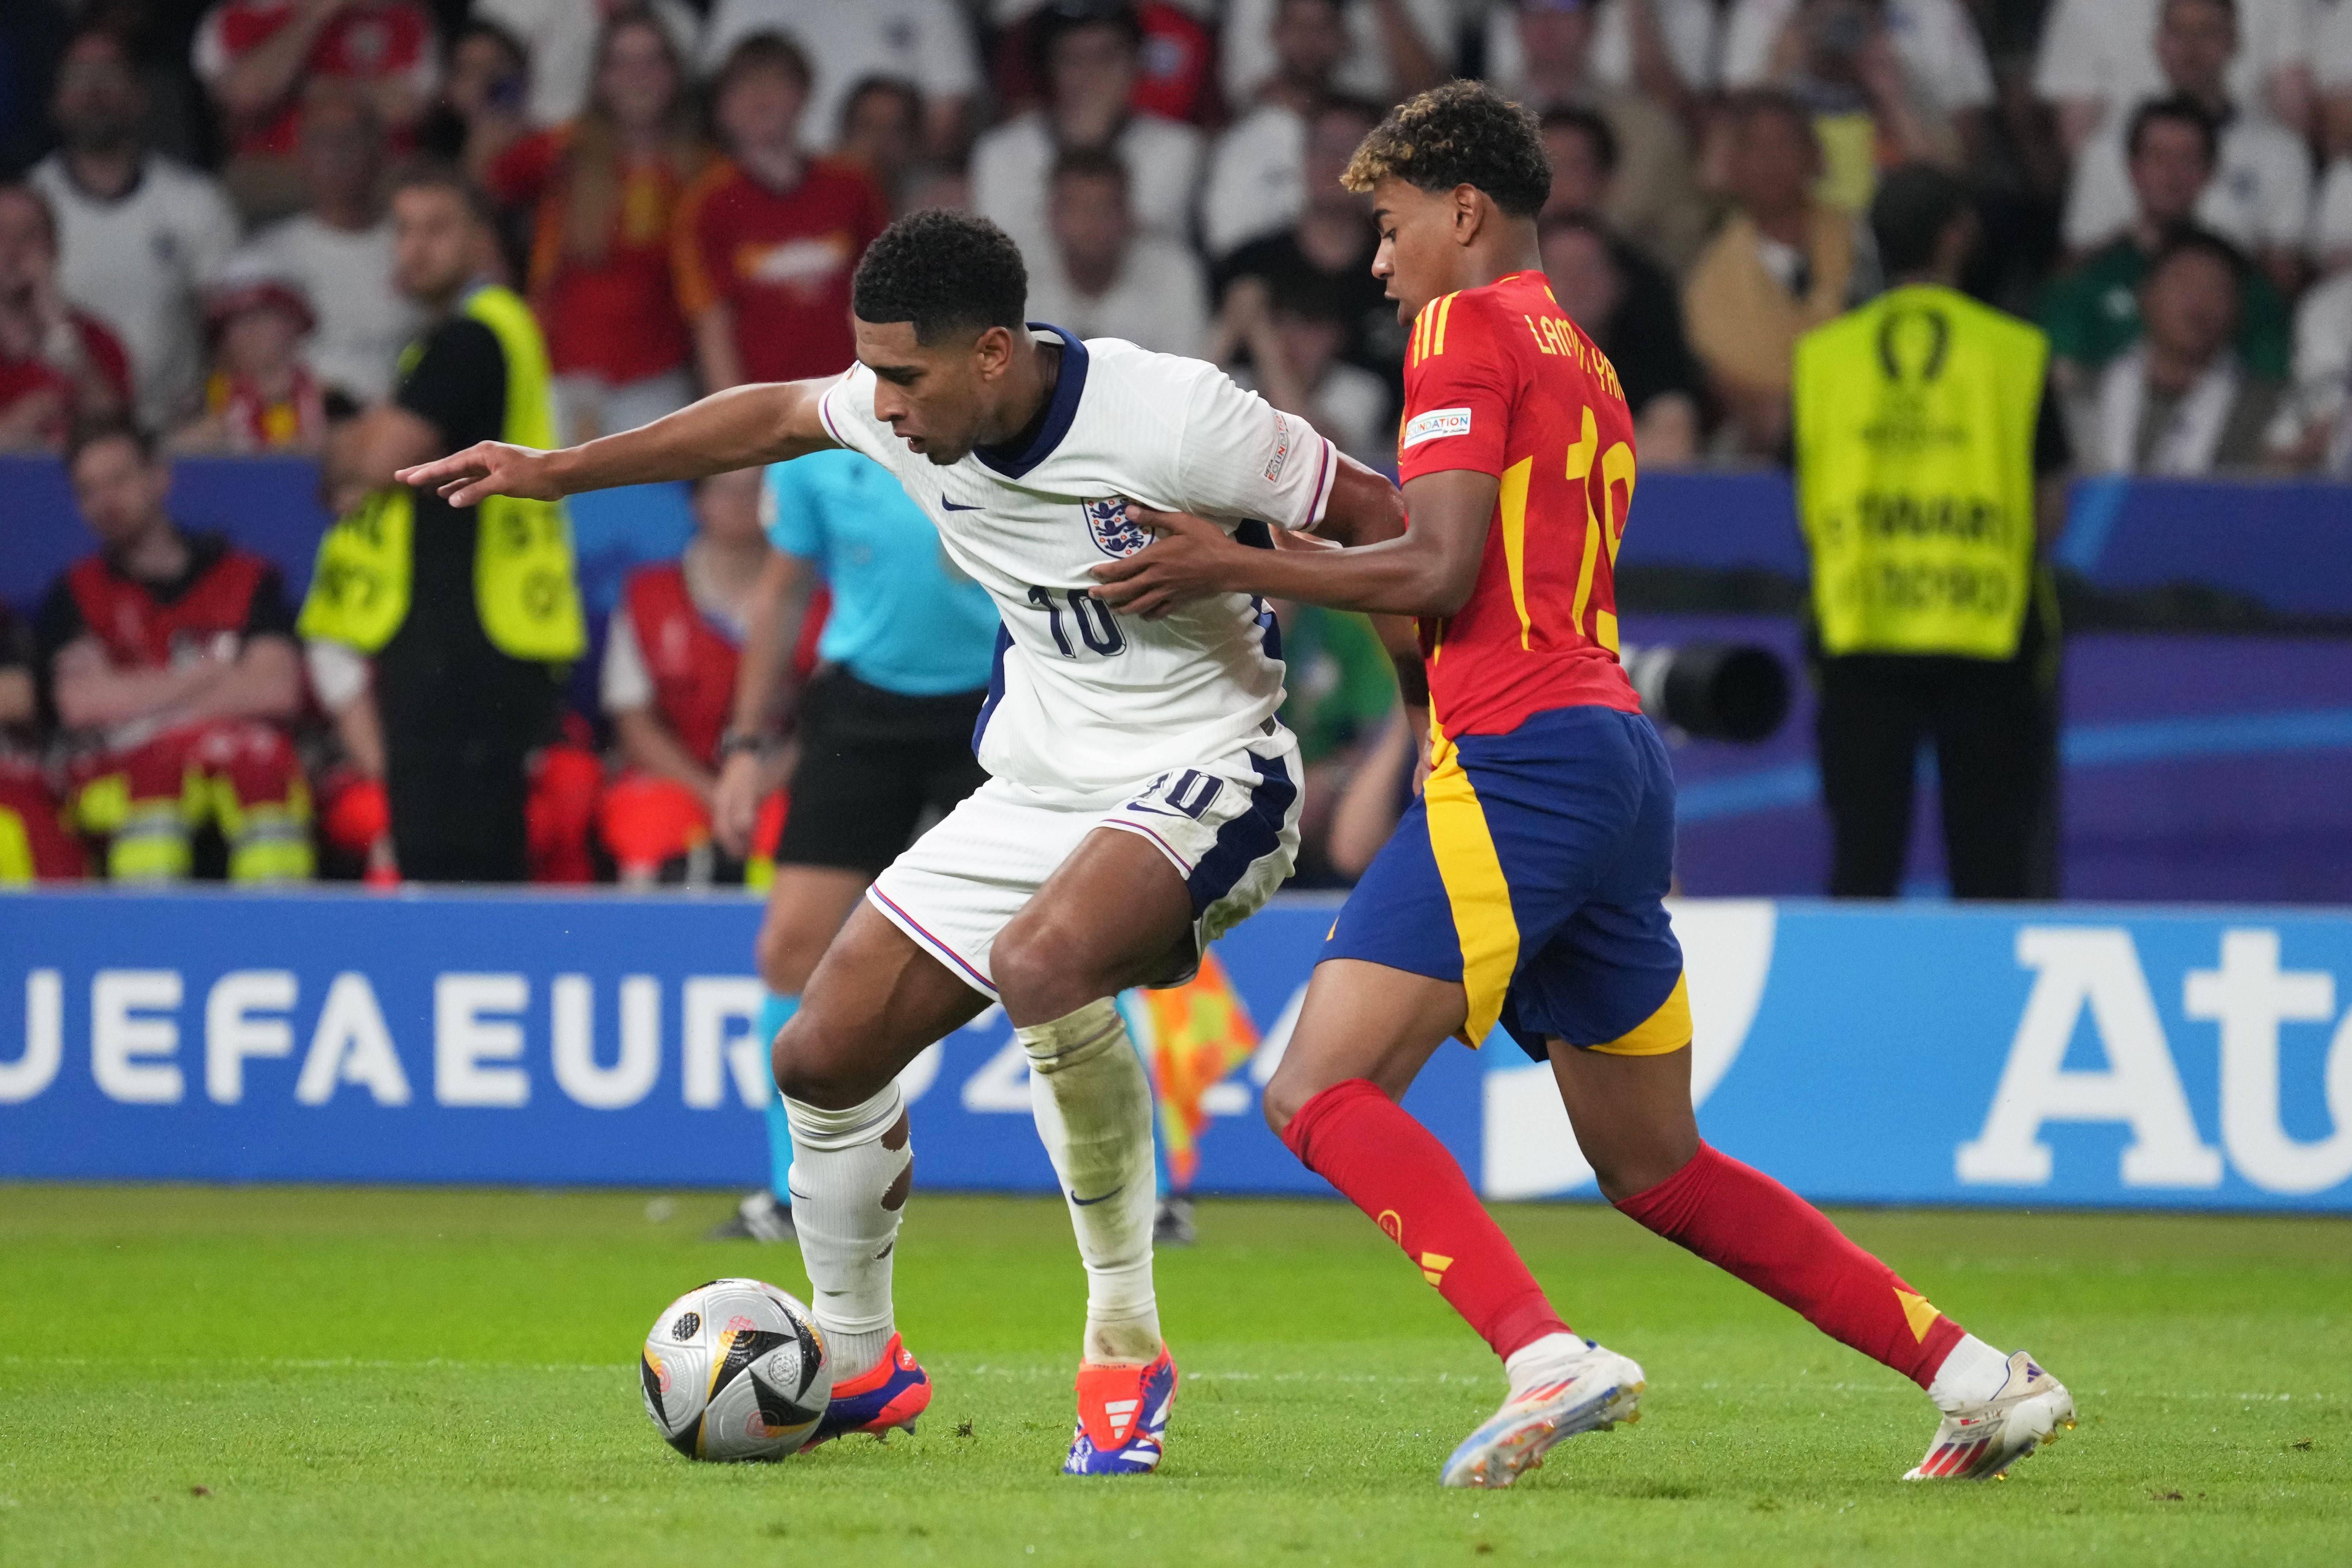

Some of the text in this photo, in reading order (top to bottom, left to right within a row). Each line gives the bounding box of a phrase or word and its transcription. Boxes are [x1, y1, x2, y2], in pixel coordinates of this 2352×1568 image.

[1566, 405, 1635, 664] 19
[1027, 585, 1126, 658] 10
[1132, 769, 1224, 821] 10
[1955, 924, 2352, 1195] At
